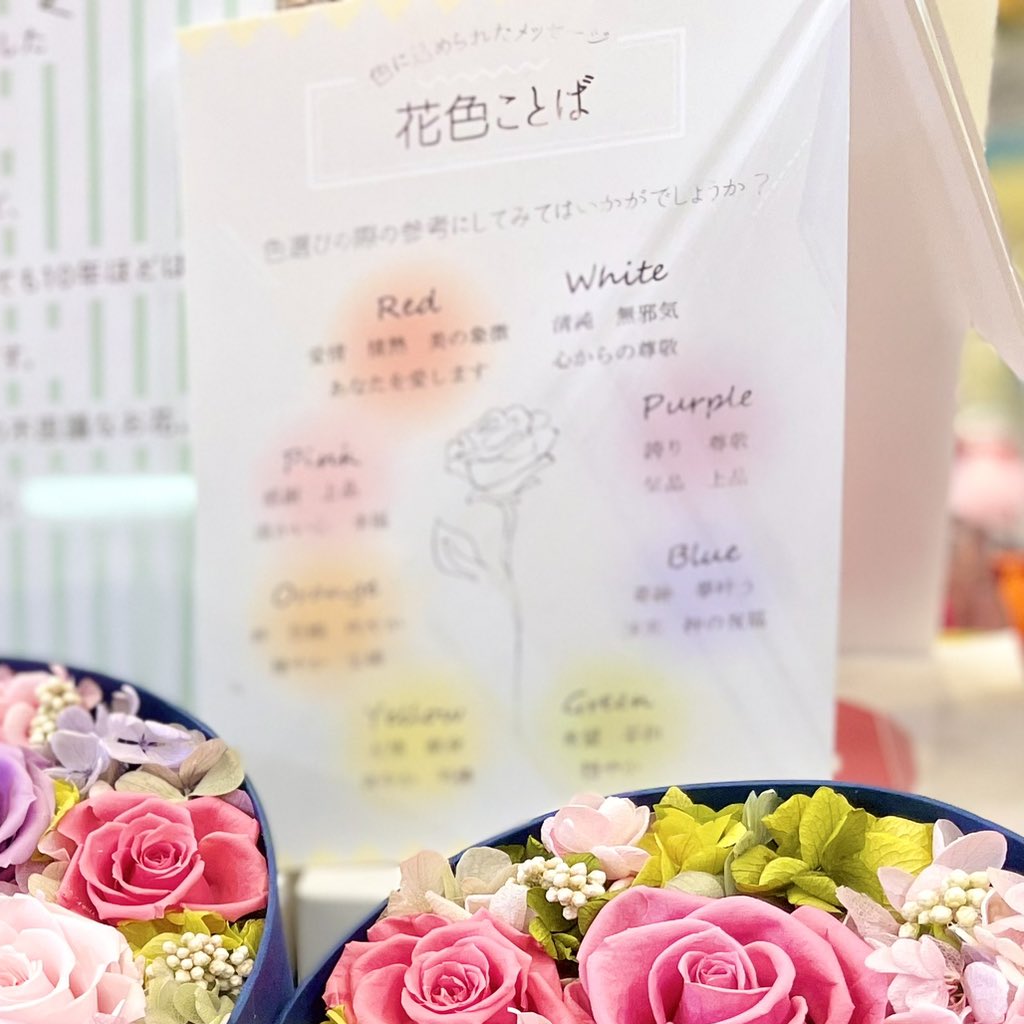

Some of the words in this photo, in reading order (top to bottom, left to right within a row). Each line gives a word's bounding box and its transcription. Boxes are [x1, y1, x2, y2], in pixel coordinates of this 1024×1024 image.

[395, 74, 595, 149] 花色ことば
[566, 260, 668, 294] White
[378, 288, 441, 320] Red
[616, 302, 679, 326] 無邪気
[553, 338, 679, 370] 心からの尊敬
[642, 384, 753, 420] Purple
[282, 442, 362, 474] Pink
[667, 542, 741, 570] Blue
